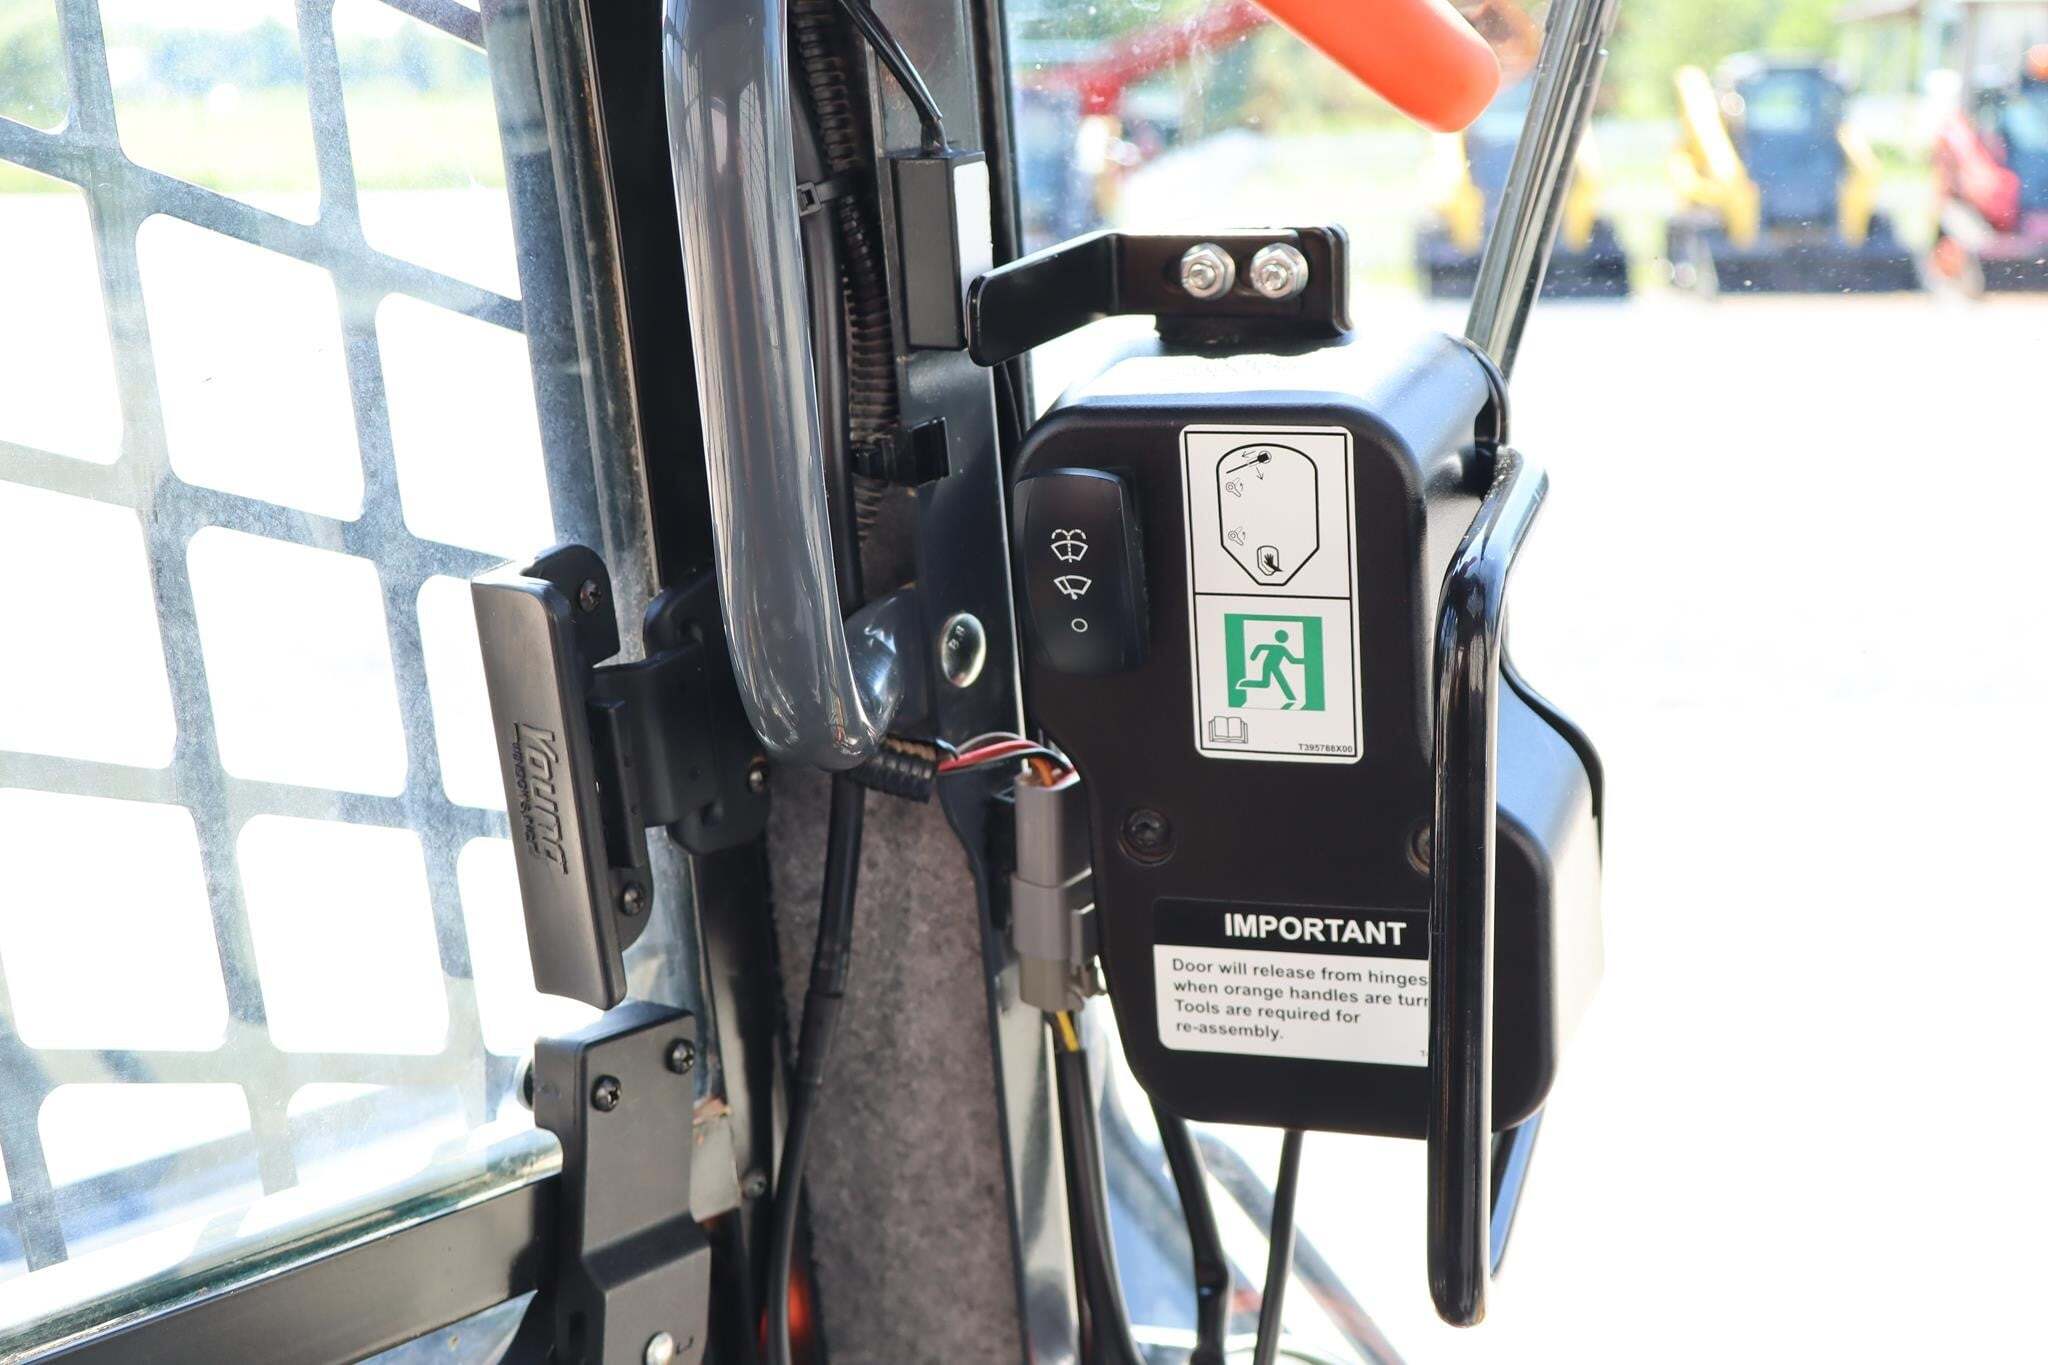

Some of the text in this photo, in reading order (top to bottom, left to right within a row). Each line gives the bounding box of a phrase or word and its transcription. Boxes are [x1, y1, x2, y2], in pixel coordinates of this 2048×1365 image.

[522, 722, 569, 875] Young
[1224, 912, 1407, 946] IMPORTANT
[1172, 958, 1428, 988] Door will release from hinges
[1173, 980, 1218, 994] when
[1224, 984, 1284, 1000] orange
[1290, 986, 1359, 1004] handles
[1365, 992, 1392, 1006] are
[1175, 999, 1360, 1024] Tools are required for
[1176, 1021, 1284, 1042] re-assembly.
